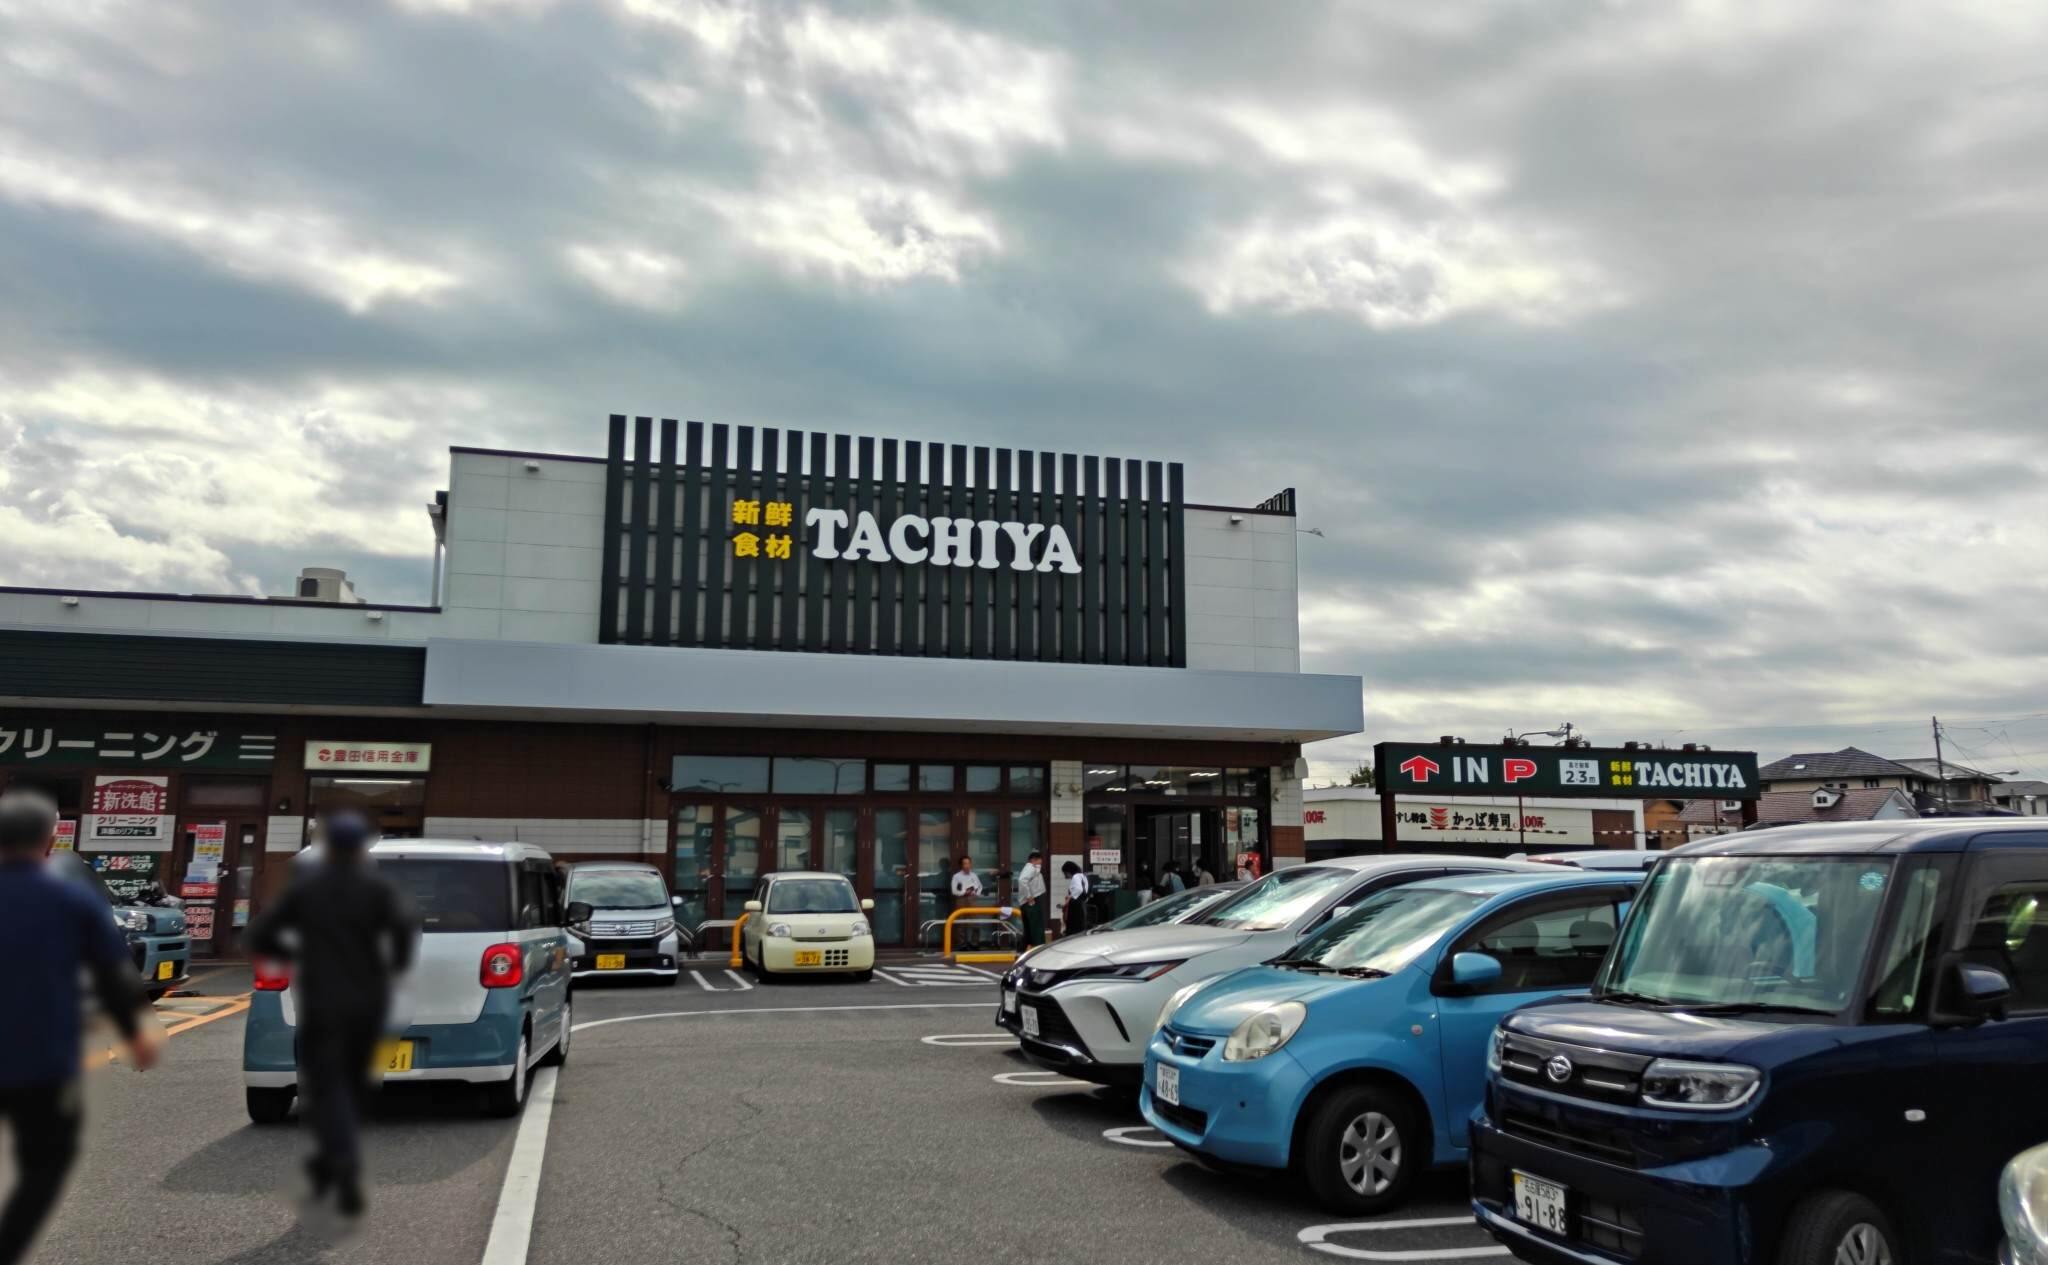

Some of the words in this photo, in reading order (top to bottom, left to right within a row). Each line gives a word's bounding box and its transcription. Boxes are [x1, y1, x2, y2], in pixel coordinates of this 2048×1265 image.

[732, 500, 793, 527] 新鮮
[732, 532, 793, 559] 食材
[805, 508, 1082, 574] TACHIYA
[334, 749, 420, 763] 豊田信用金庫
[1453, 756, 1489, 783] IN
[1634, 761, 1746, 788] TACHIYA
[102, 789, 158, 812] 新洗館
[97, 816, 159, 825] クリーニング
[1524, 1195, 1567, 1232] 91-88
